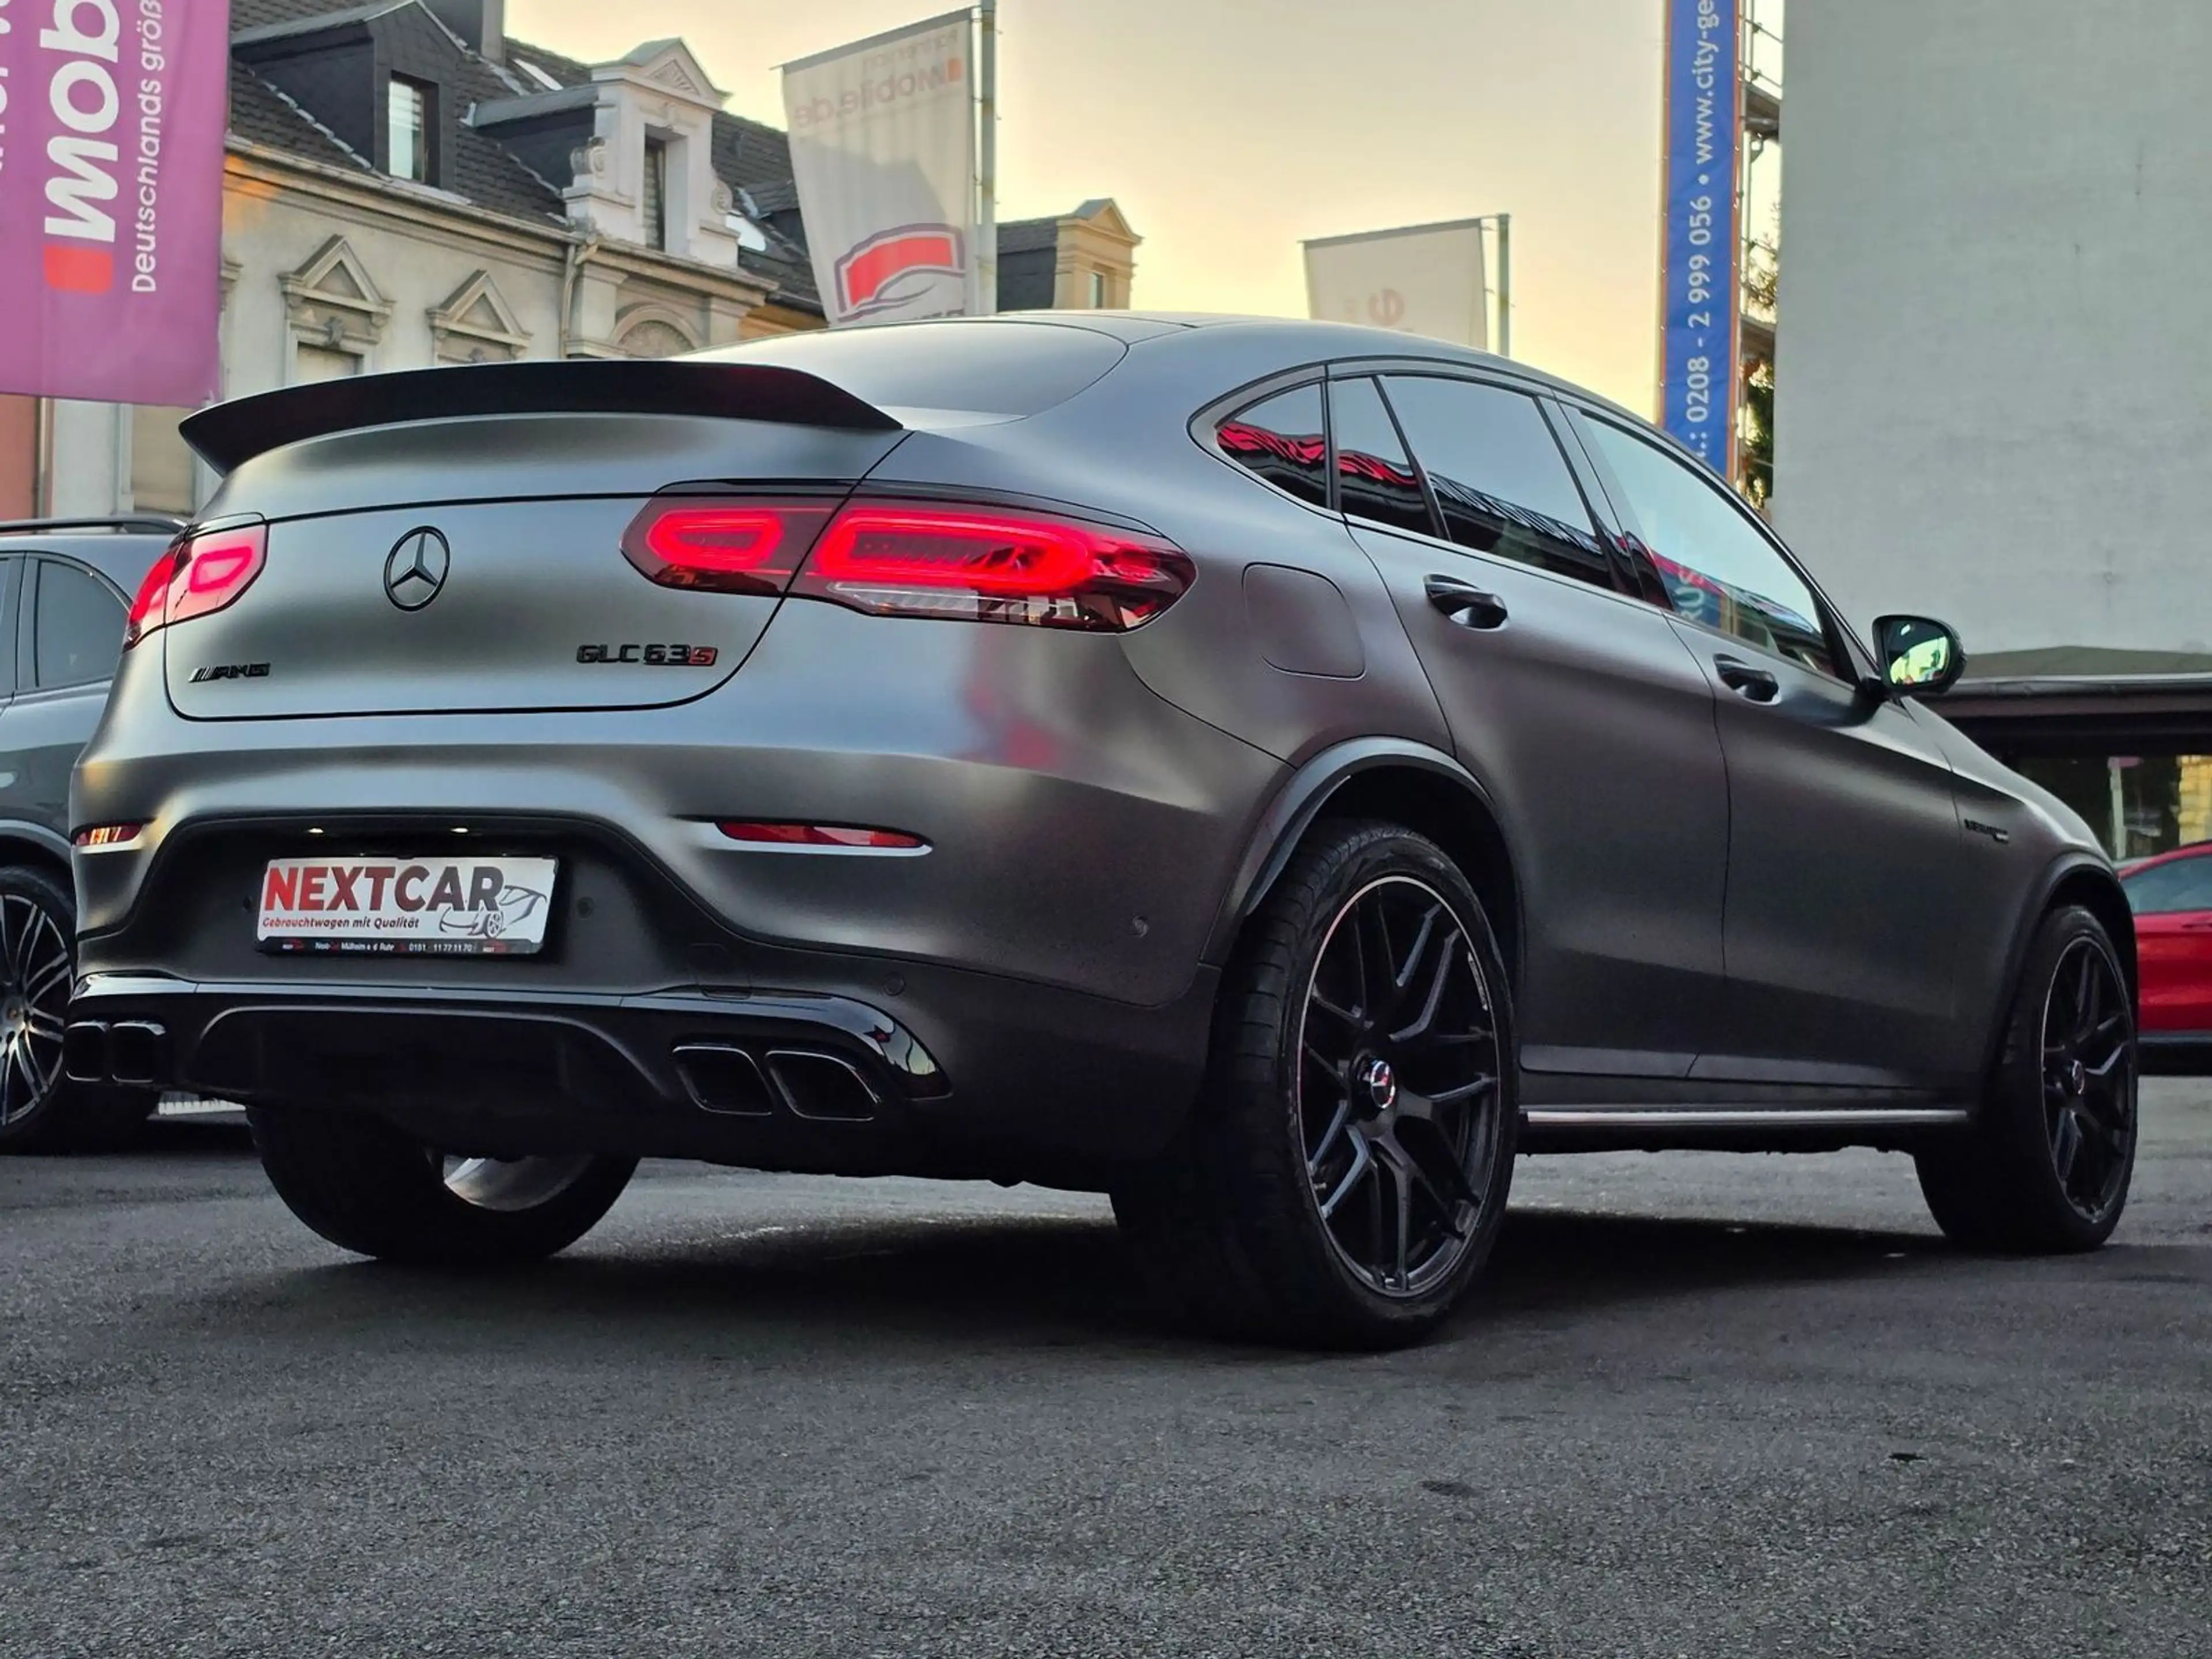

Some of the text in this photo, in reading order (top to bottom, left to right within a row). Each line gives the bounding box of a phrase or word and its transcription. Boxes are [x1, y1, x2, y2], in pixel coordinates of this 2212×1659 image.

[131, 78, 162, 292] Deutschlands
[1688, 195, 1711, 245] 056
[1688, 254, 1711, 304] 999
[1688, 312, 1710, 329] 2
[1686, 355, 1709, 422] 0208
[264, 865, 505, 912] NEXTCAR
[263, 916, 420, 930] Gebrauchtwagen mit Qualität
